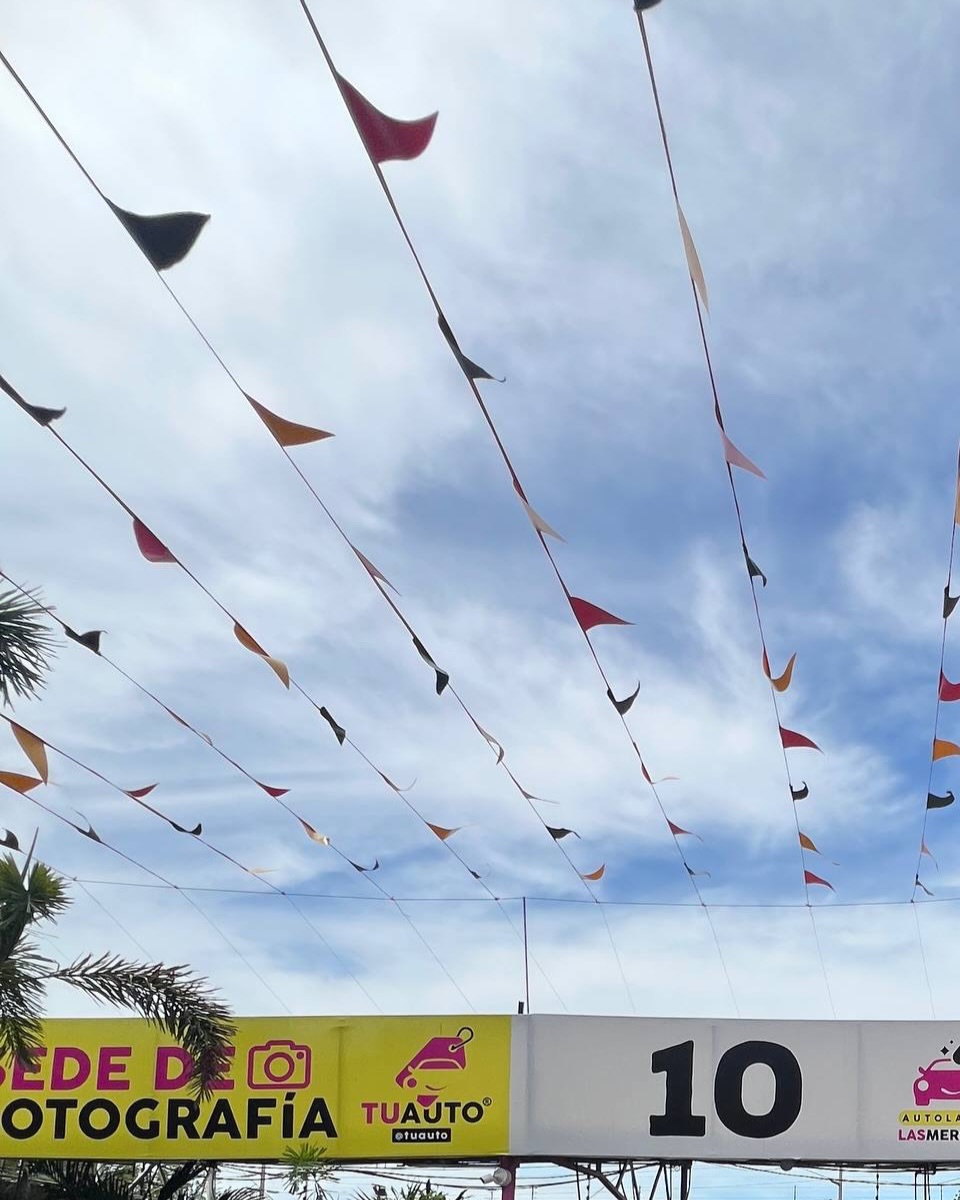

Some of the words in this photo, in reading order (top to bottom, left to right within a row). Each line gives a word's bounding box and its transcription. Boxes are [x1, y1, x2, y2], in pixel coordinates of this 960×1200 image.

[0, 1046, 131, 1091] EDE
[649, 1040, 802, 1138] 10
[395, 1130, 448, 1141] @tuauto
